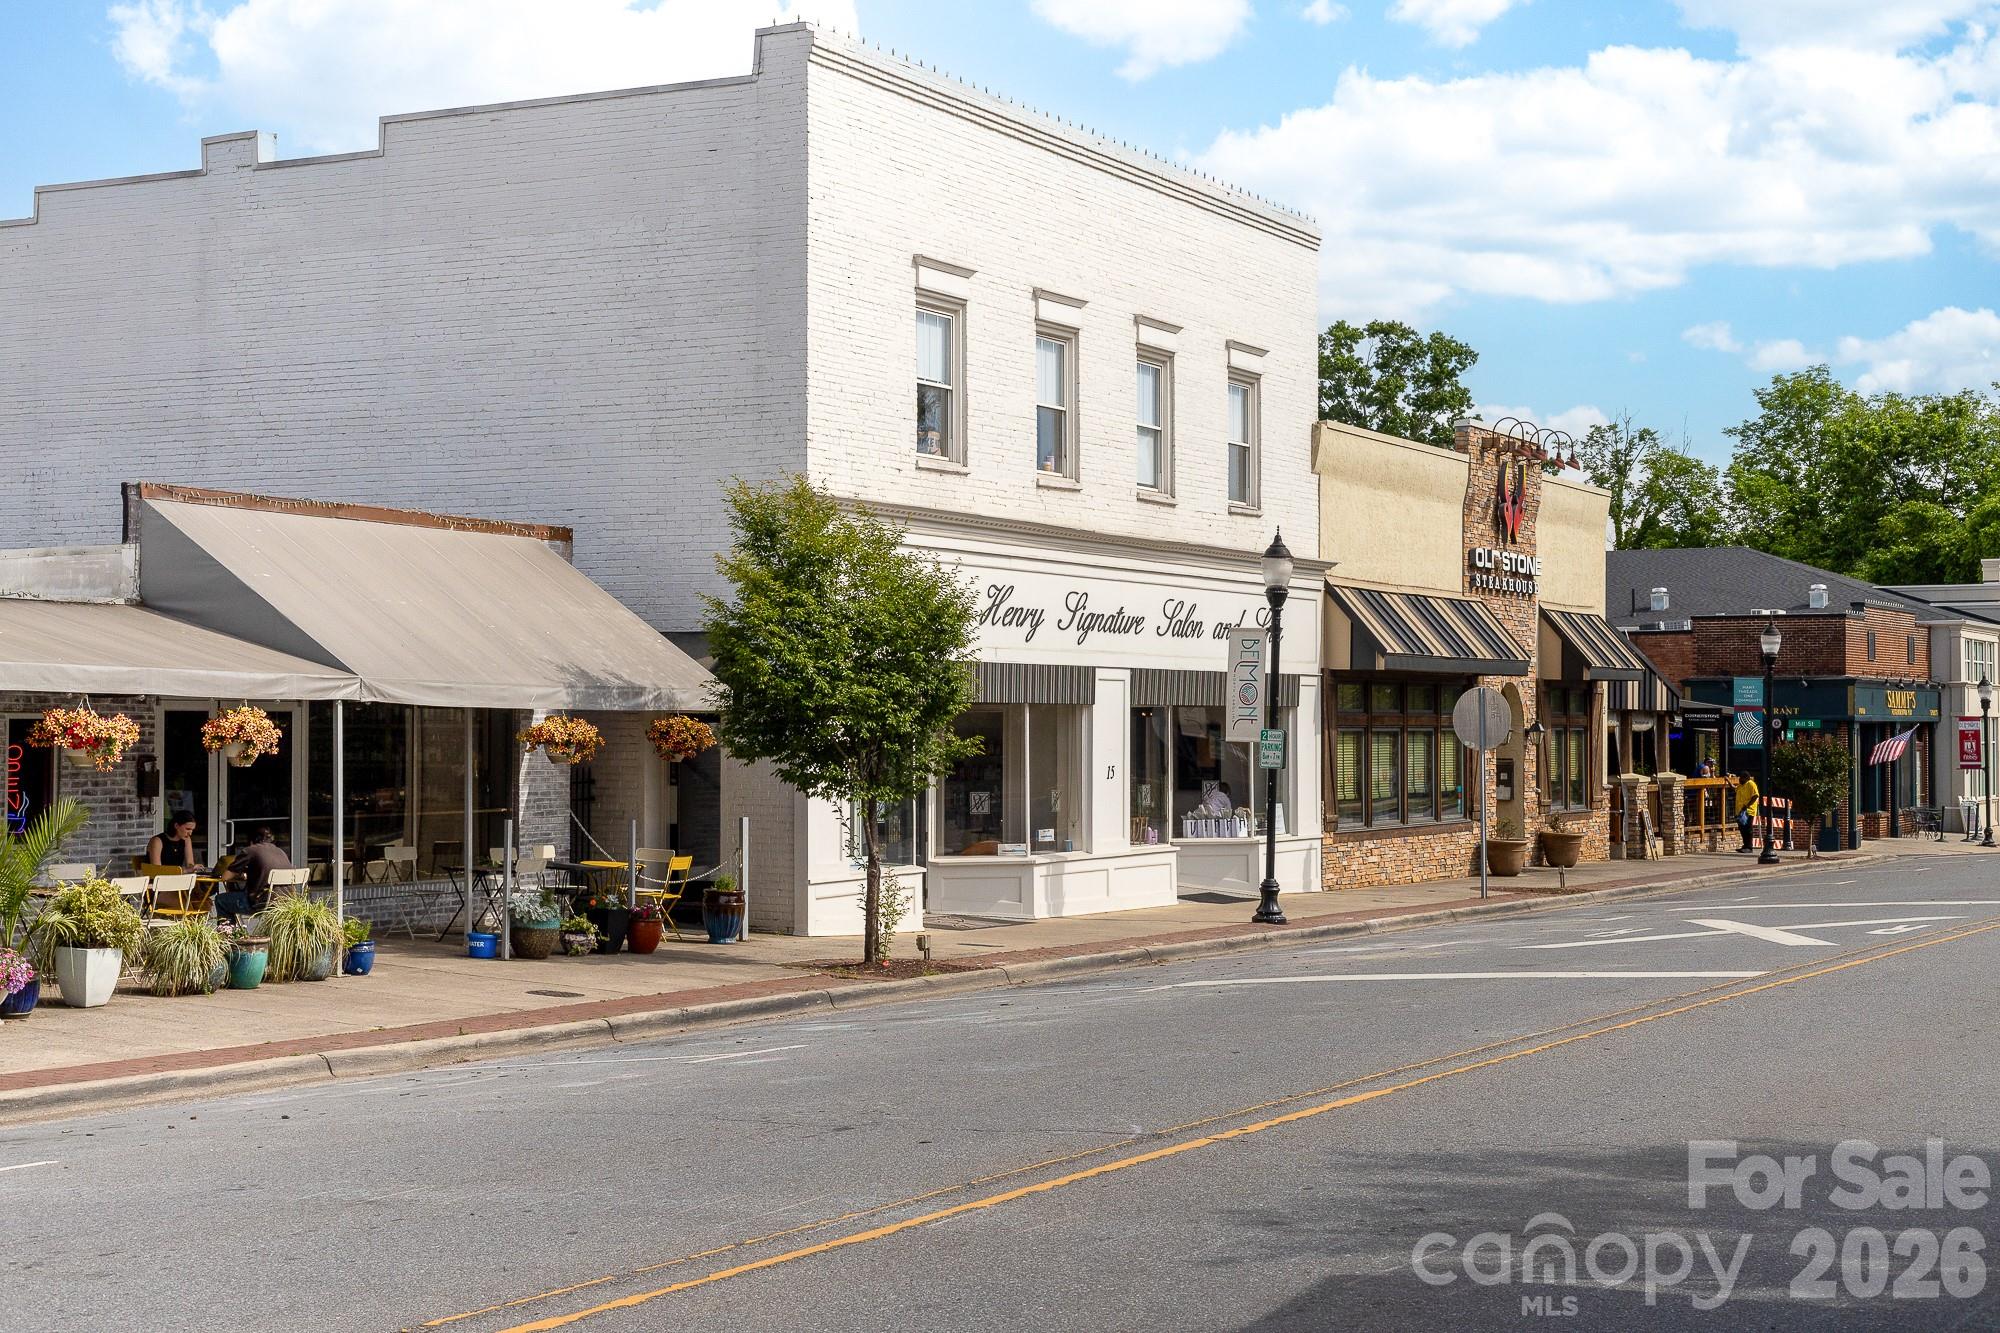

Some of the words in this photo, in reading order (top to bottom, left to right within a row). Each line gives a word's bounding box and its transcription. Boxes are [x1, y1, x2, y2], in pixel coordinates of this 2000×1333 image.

[1502, 550, 1542, 576] STONE
[1475, 573, 1540, 594] STEAKHOUSE
[979, 584, 1045, 643] Henry
[1057, 591, 1145, 645] Signature
[1156, 598, 1204, 639] Salon
[1887, 690, 1917, 709] SAMMY'S
[1262, 731, 1267, 740] 2
[1106, 765, 1116, 780] 15
